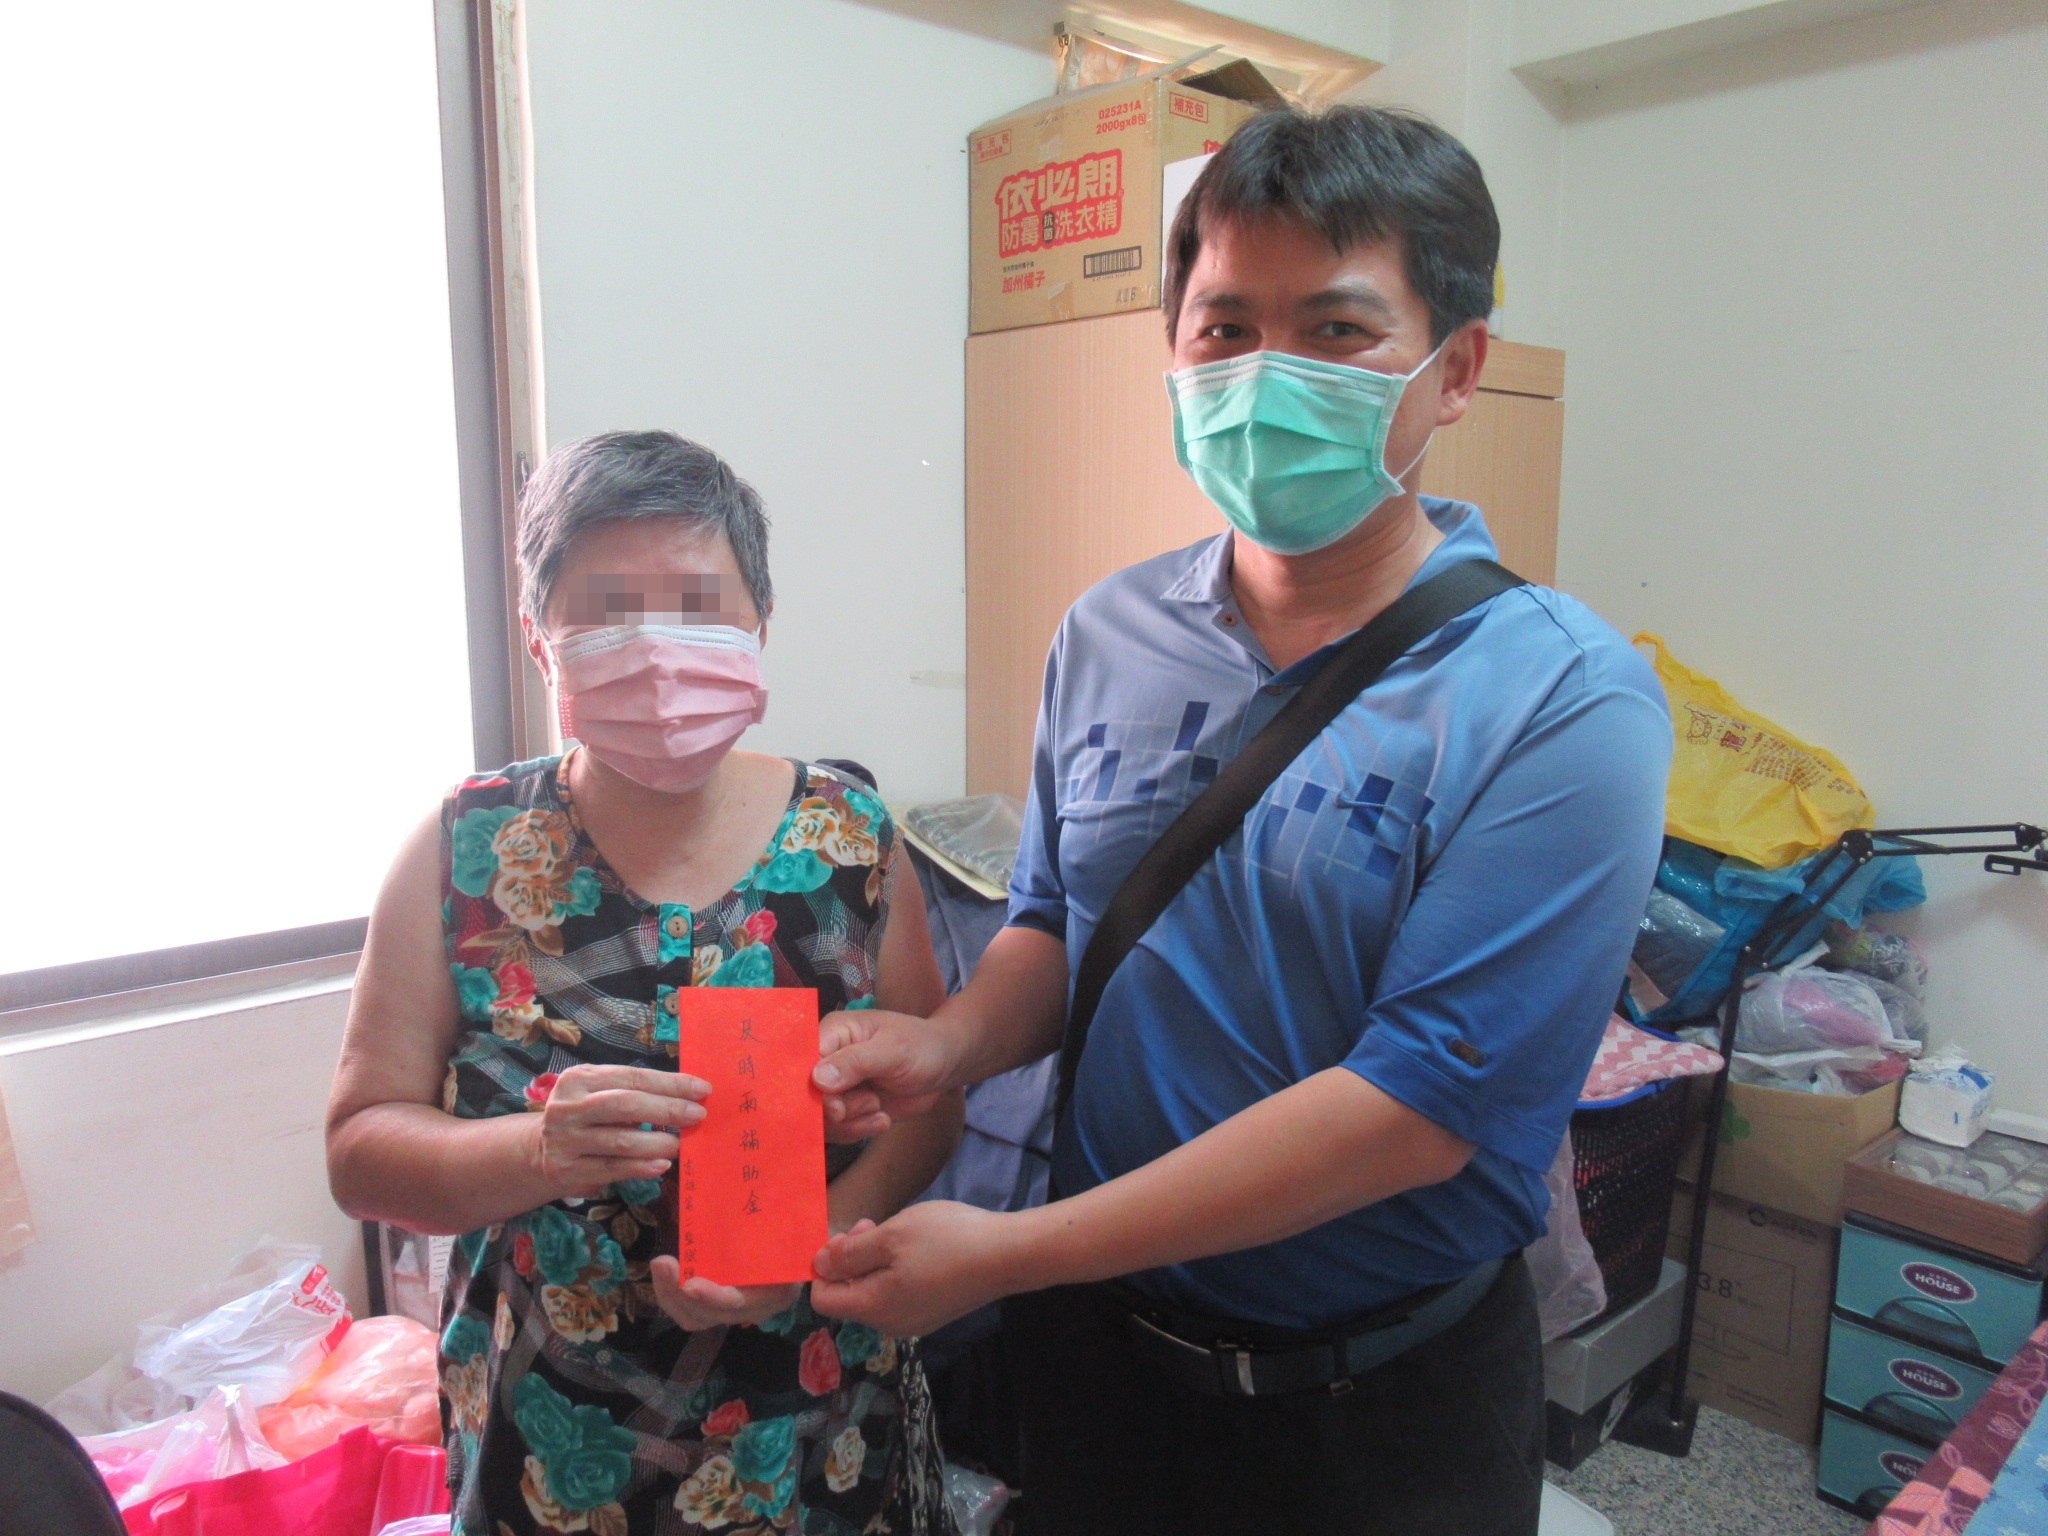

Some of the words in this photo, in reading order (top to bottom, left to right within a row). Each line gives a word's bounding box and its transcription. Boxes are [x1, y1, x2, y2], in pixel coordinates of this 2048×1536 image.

[1098, 100, 1142, 120] 025231A
[1174, 97, 1204, 118] 補充包
[1096, 113, 1147, 135] 2000gx8包
[998, 154, 1119, 220] 依必朗
[1915, 1272, 1961, 1295] HOUSE
[1902, 1369, 1948, 1392] HOUSE
